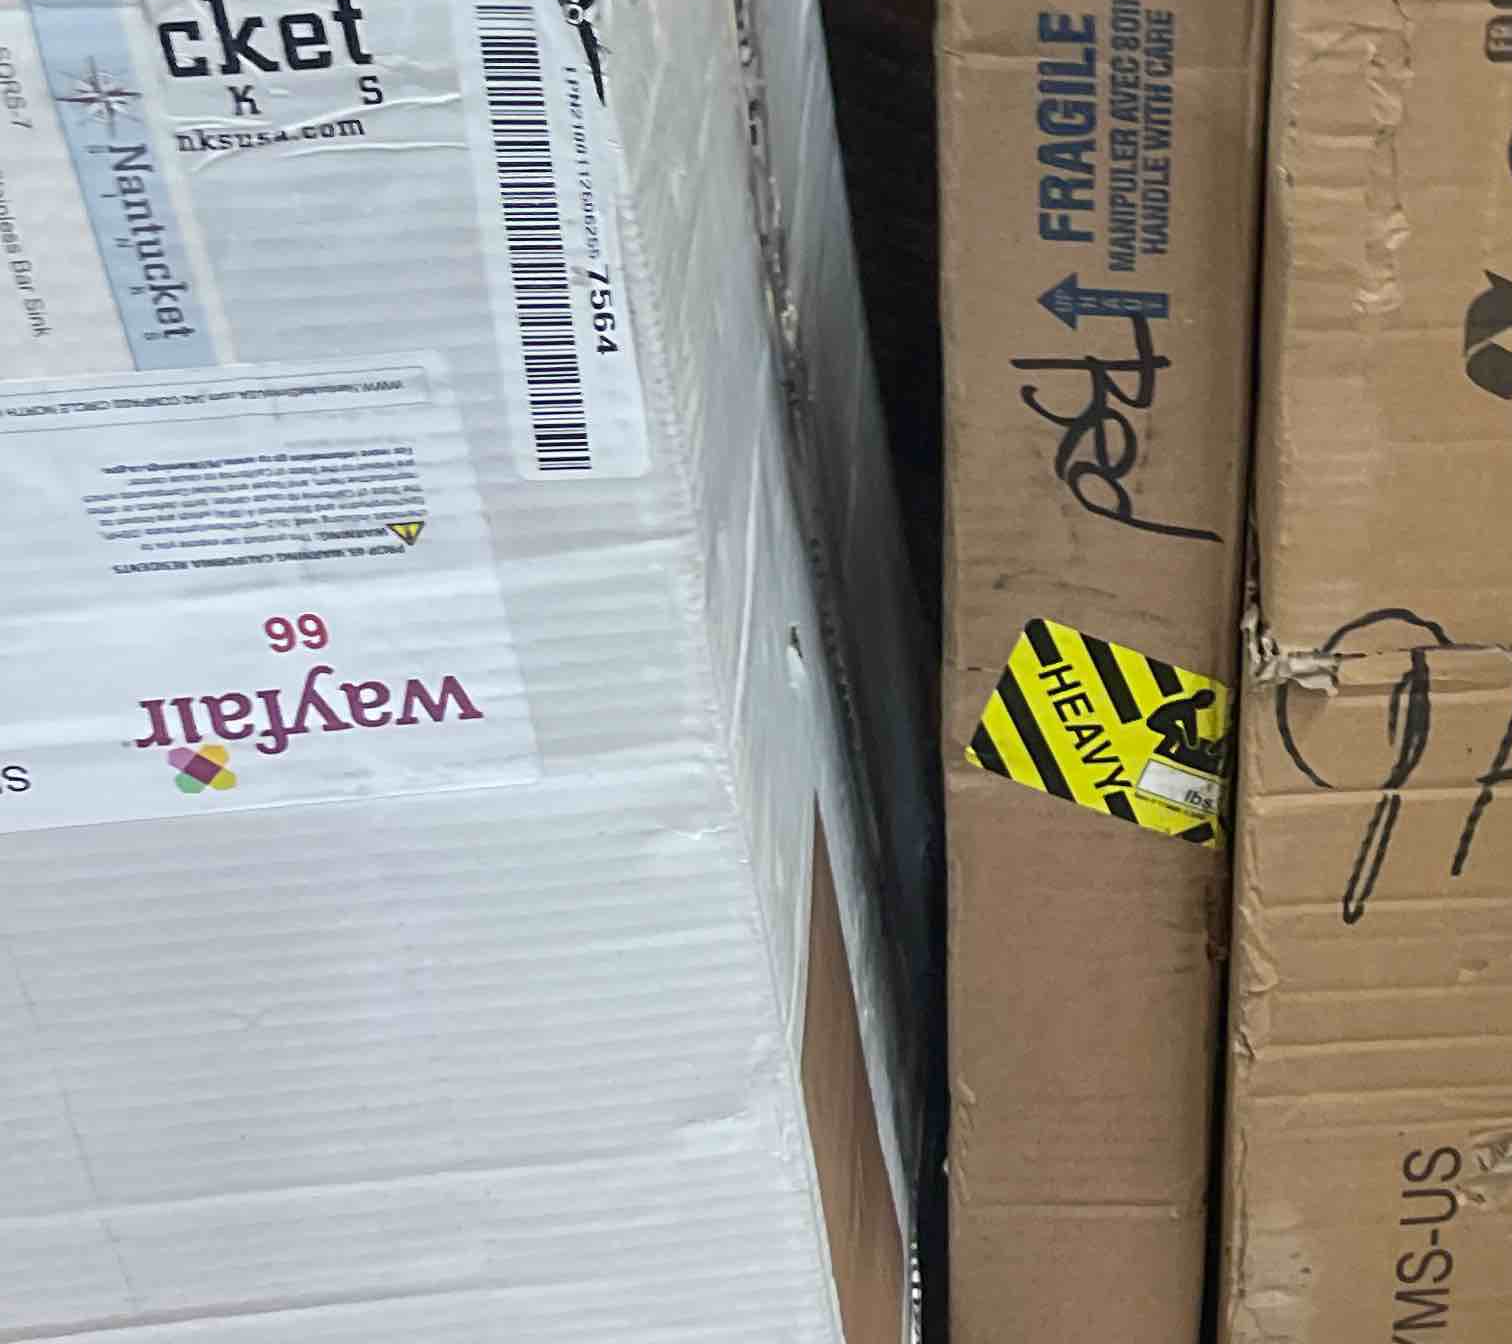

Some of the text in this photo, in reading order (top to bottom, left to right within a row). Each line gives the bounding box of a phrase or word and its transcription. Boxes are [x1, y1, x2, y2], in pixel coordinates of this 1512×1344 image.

[1038, 10, 1097, 244] FRAGILE
[1111, 56, 1140, 124] AVEC
[1140, 9, 1175, 255] HANDLE WITH CARE
[107, 142, 196, 340] Nantucket
[1109, 129, 1141, 272] MANIPULER
[586, 265, 620, 355] 7564
[135, 665, 485, 755] wayfair
[1037, 660, 1134, 798] HEAVY
